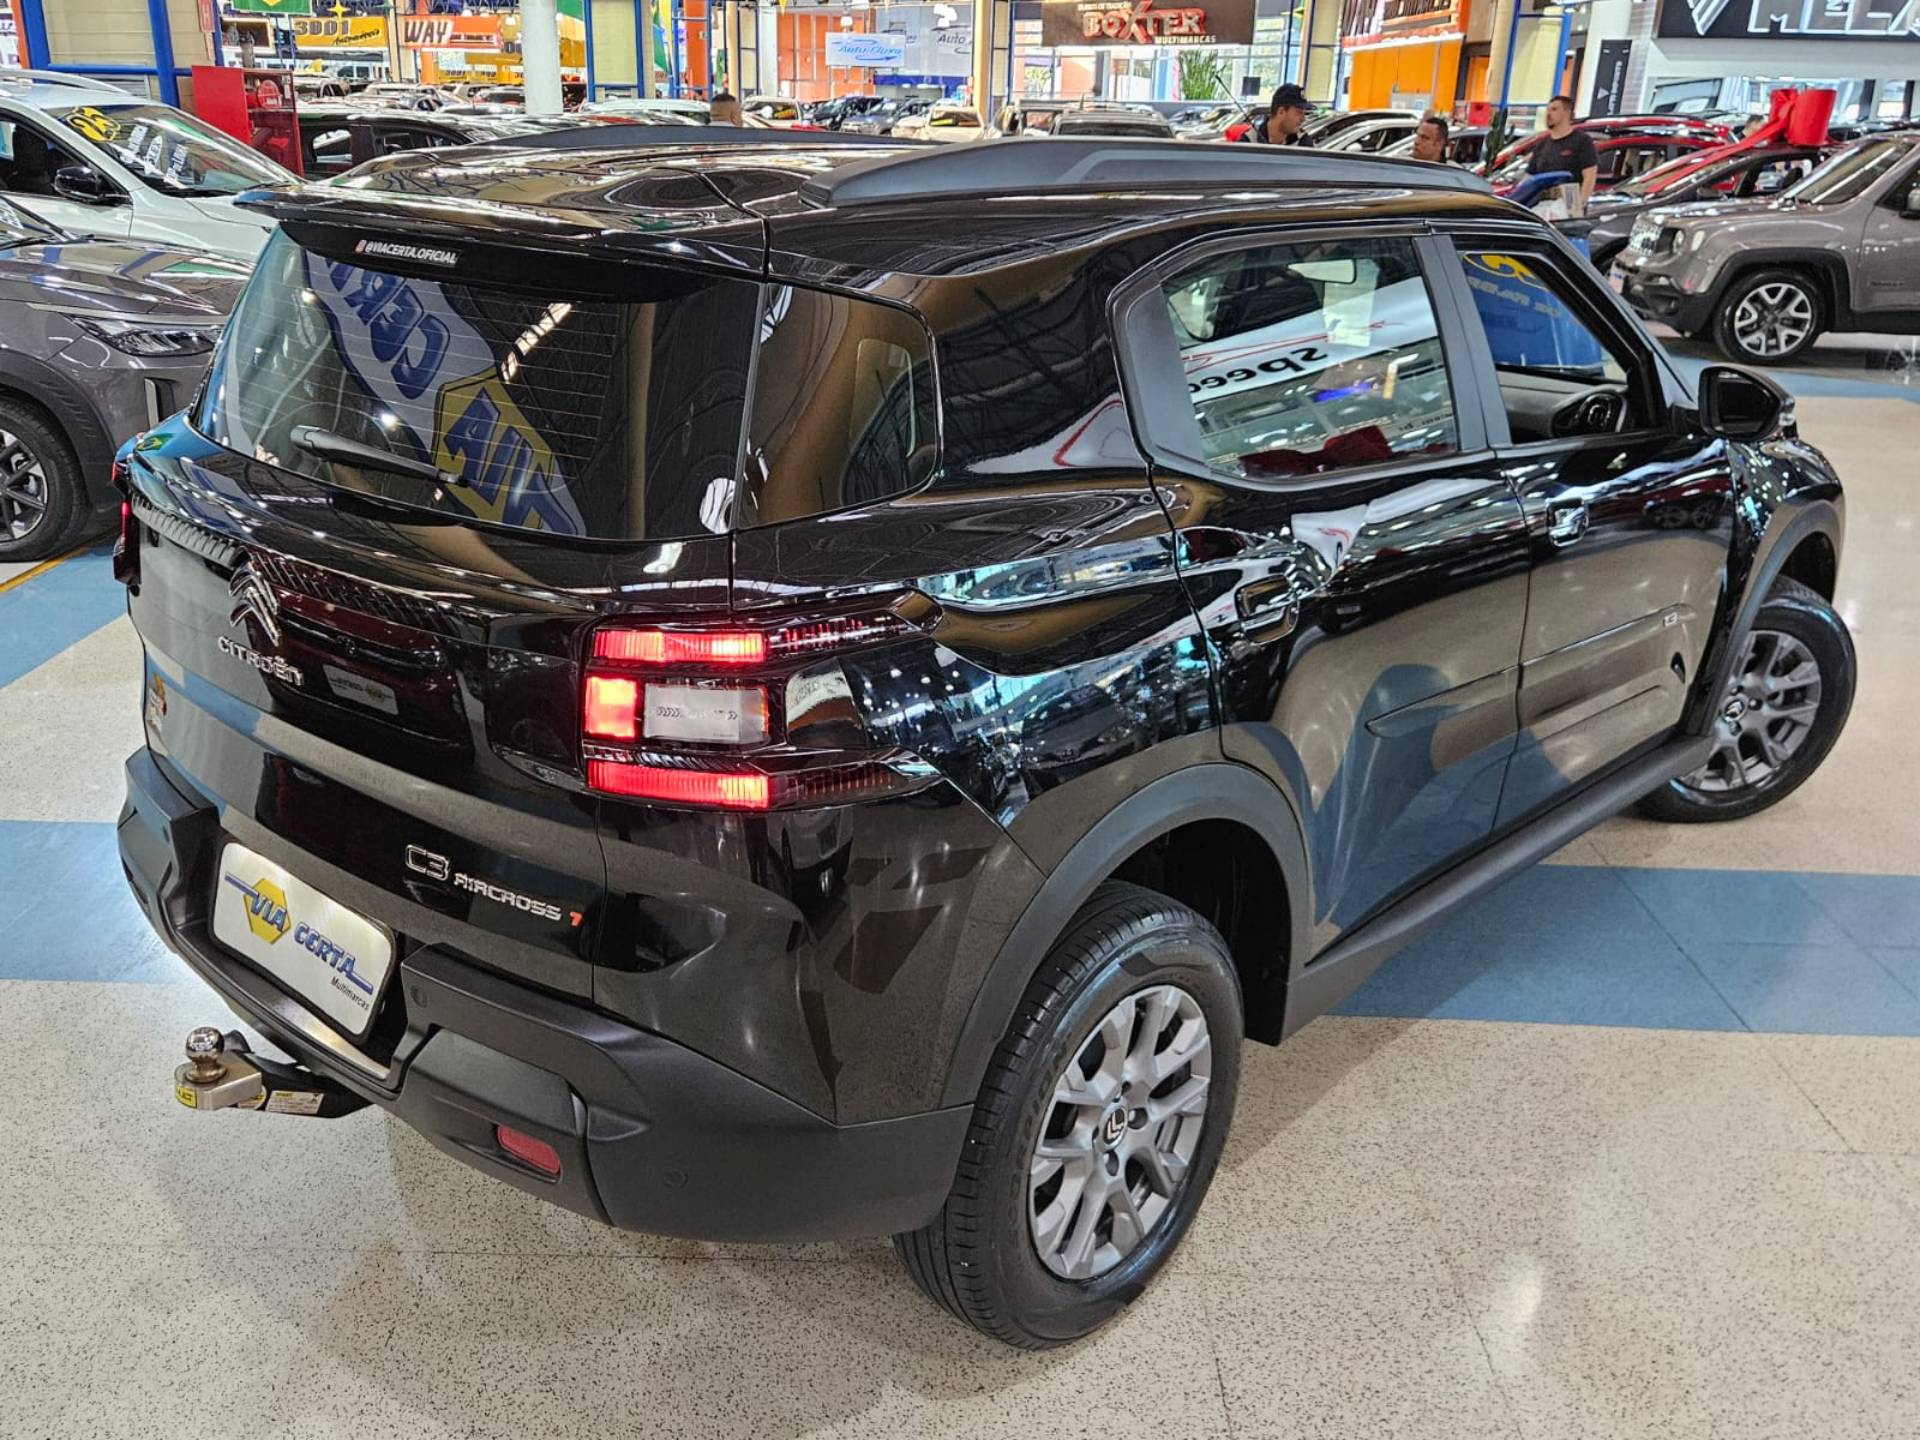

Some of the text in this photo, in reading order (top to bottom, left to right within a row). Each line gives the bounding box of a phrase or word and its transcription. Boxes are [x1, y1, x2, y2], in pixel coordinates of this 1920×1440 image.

[404, 20, 449, 44] WAY
[1083, 0, 1206, 43] BOXTER
[1154, 35, 1217, 45] MULTIMARCAS
[365, 240, 457, 264] @VIACERTA.OFICIAL
[405, 844, 450, 882] C3
[453, 872, 562, 922] AIRCROSS
[249, 893, 356, 978] VIA CERTA
[331, 976, 370, 1012] Multimarcas
